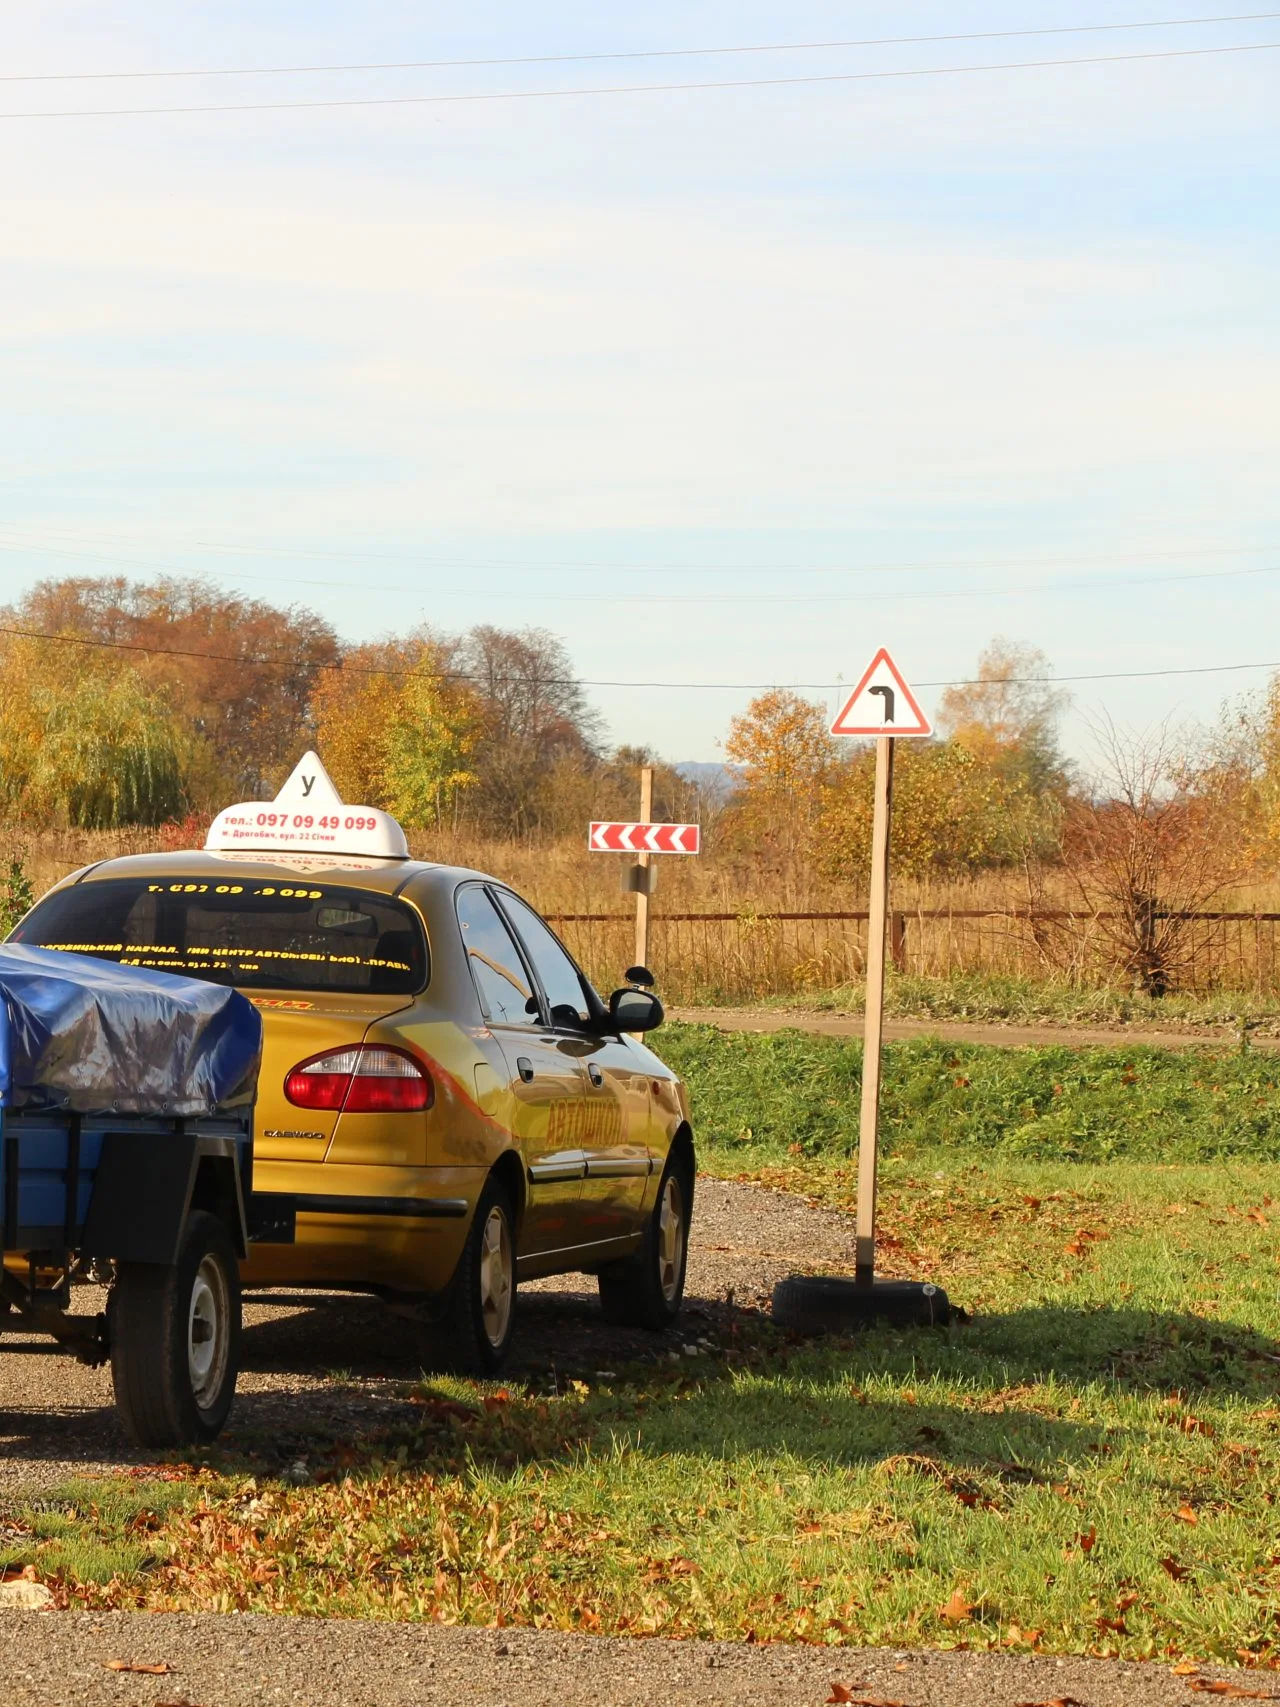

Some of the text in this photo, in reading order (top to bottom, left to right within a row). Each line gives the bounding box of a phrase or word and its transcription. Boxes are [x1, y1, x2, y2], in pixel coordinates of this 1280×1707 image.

[256, 813, 289, 828] 097
[293, 815, 314, 828] 09
[318, 816, 340, 829] 49
[344, 817, 377, 831] 099
[215, 885, 244, 894] 09
[279, 888, 322, 899] 099
[212, 948, 254, 957] ЦЕНТР
